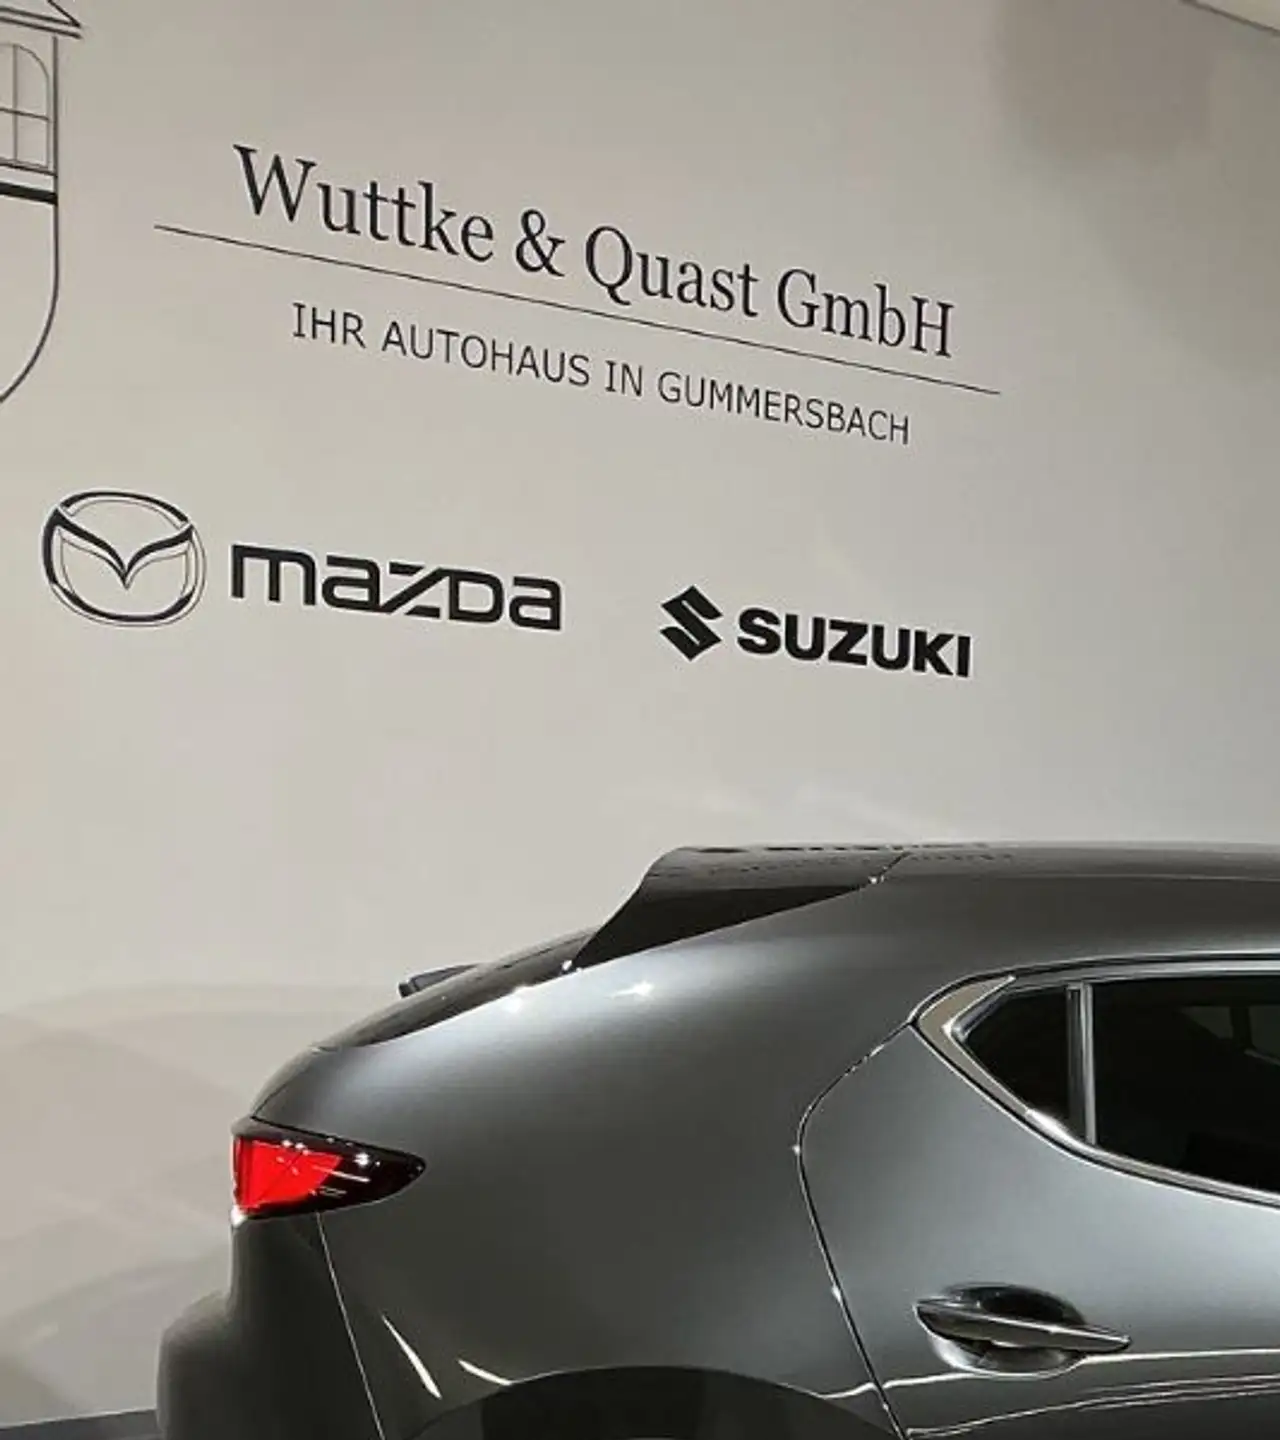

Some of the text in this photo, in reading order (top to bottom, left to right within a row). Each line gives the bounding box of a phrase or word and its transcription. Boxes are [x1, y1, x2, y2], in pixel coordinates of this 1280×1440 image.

[232, 143, 955, 359] Wuttke & Quast GmbH
[292, 302, 911, 446] IHR AUTOHAUS IN GUMMERSBACH
[736, 607, 972, 679] SUZUKI
